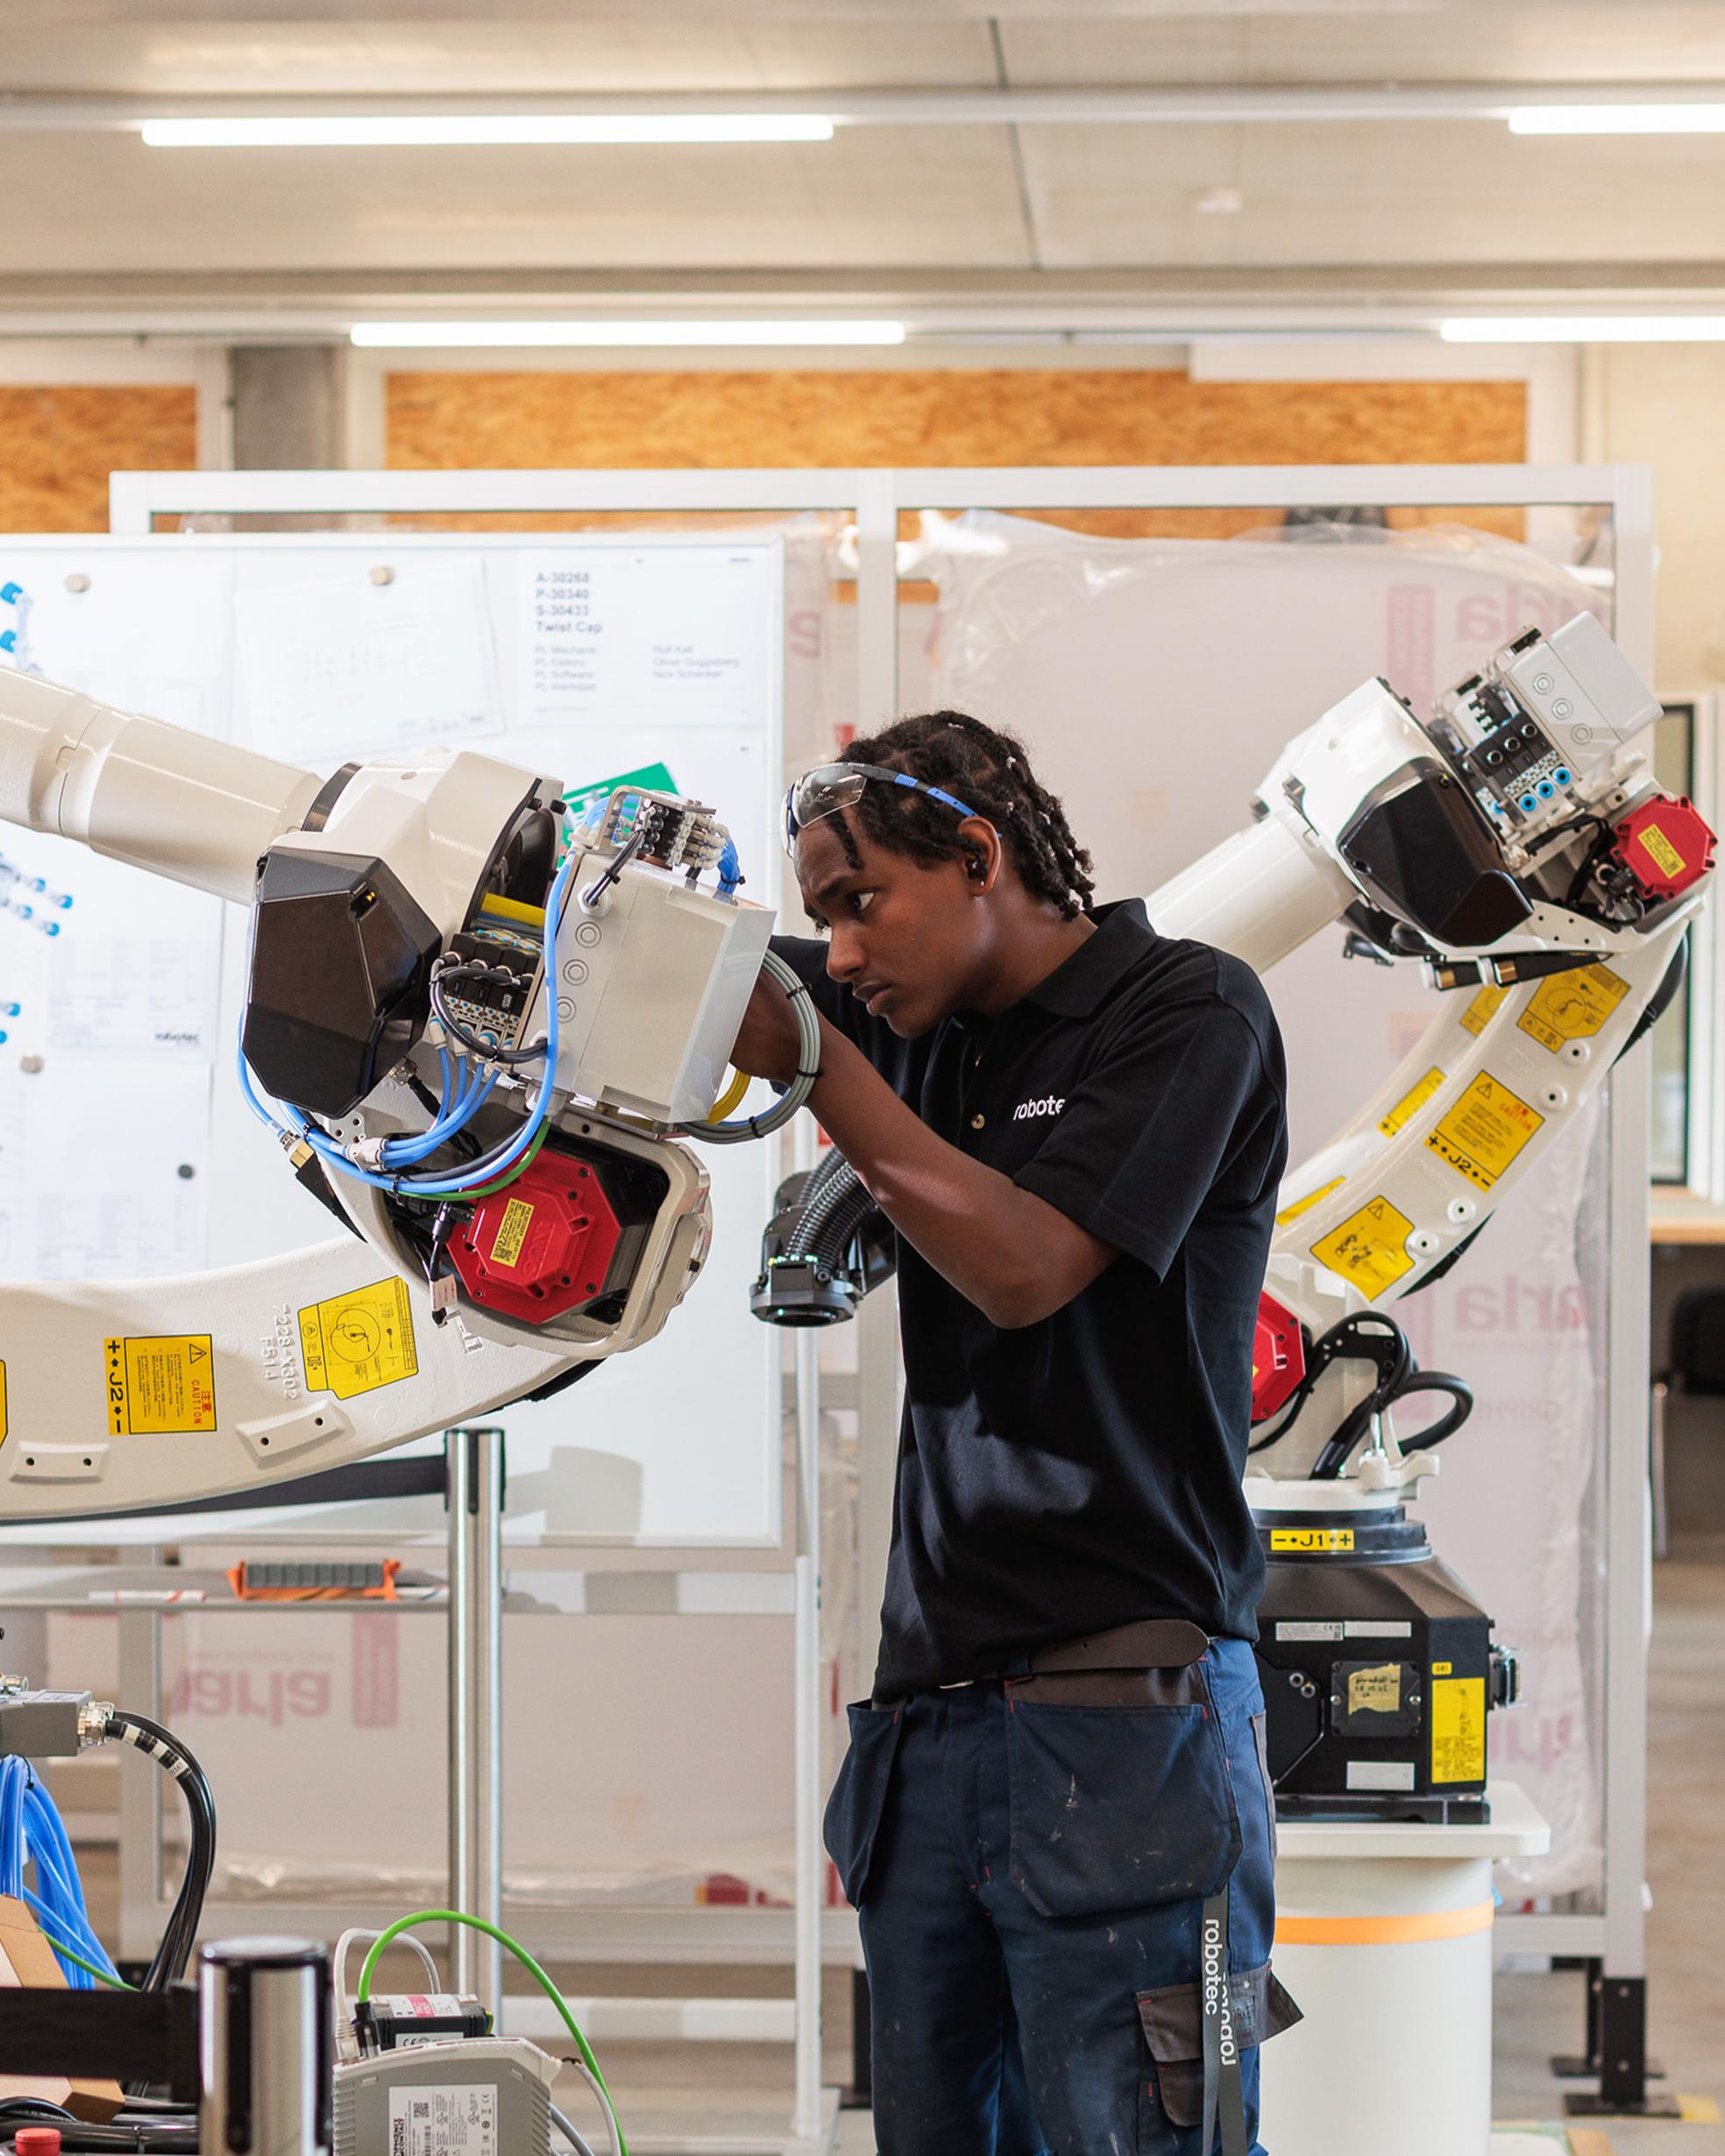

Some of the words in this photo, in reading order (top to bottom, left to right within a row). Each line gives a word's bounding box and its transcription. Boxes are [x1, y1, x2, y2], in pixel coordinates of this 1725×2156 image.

[576, 621, 603, 635] Cap
[1448, 1155, 1473, 1174] J2
[109, 1372, 124, 1402] J2
[191, 1379, 202, 1425] CAUTION
[1300, 1533, 1323, 1547] J1
[1203, 1918, 1223, 2016] robotec
